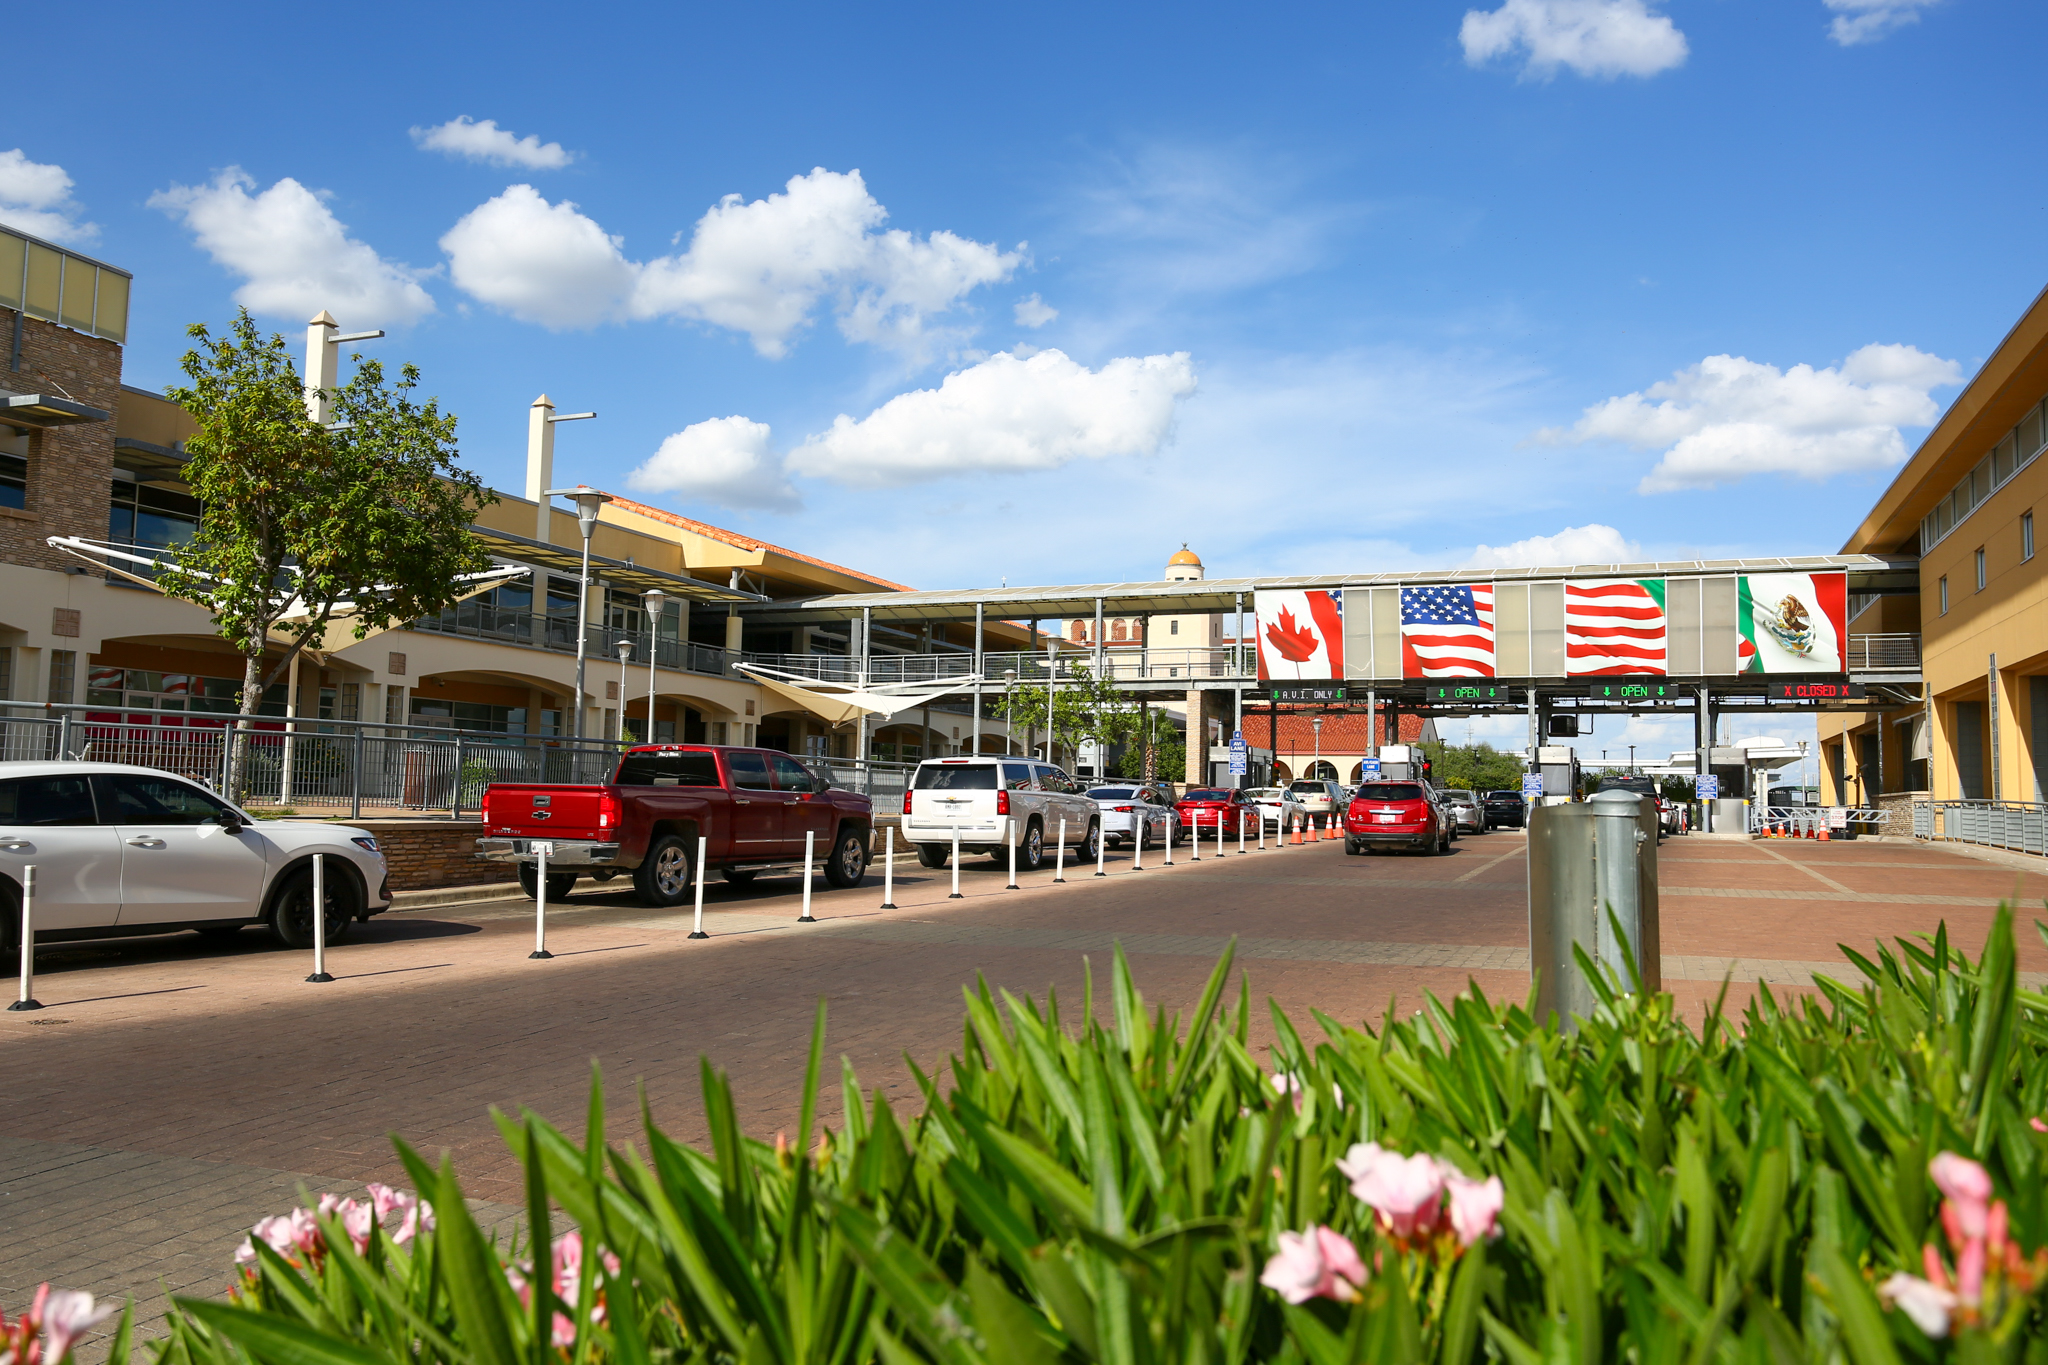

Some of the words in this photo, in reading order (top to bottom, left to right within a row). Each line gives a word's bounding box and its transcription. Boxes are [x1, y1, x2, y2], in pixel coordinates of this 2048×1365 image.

[1282, 690, 1309, 699] A.V.I.
[1313, 690, 1333, 699] ONLY
[1454, 688, 1480, 698] OPEN
[1620, 686, 1648, 697] OPEN
[1796, 685, 1837, 697] CLOSED
